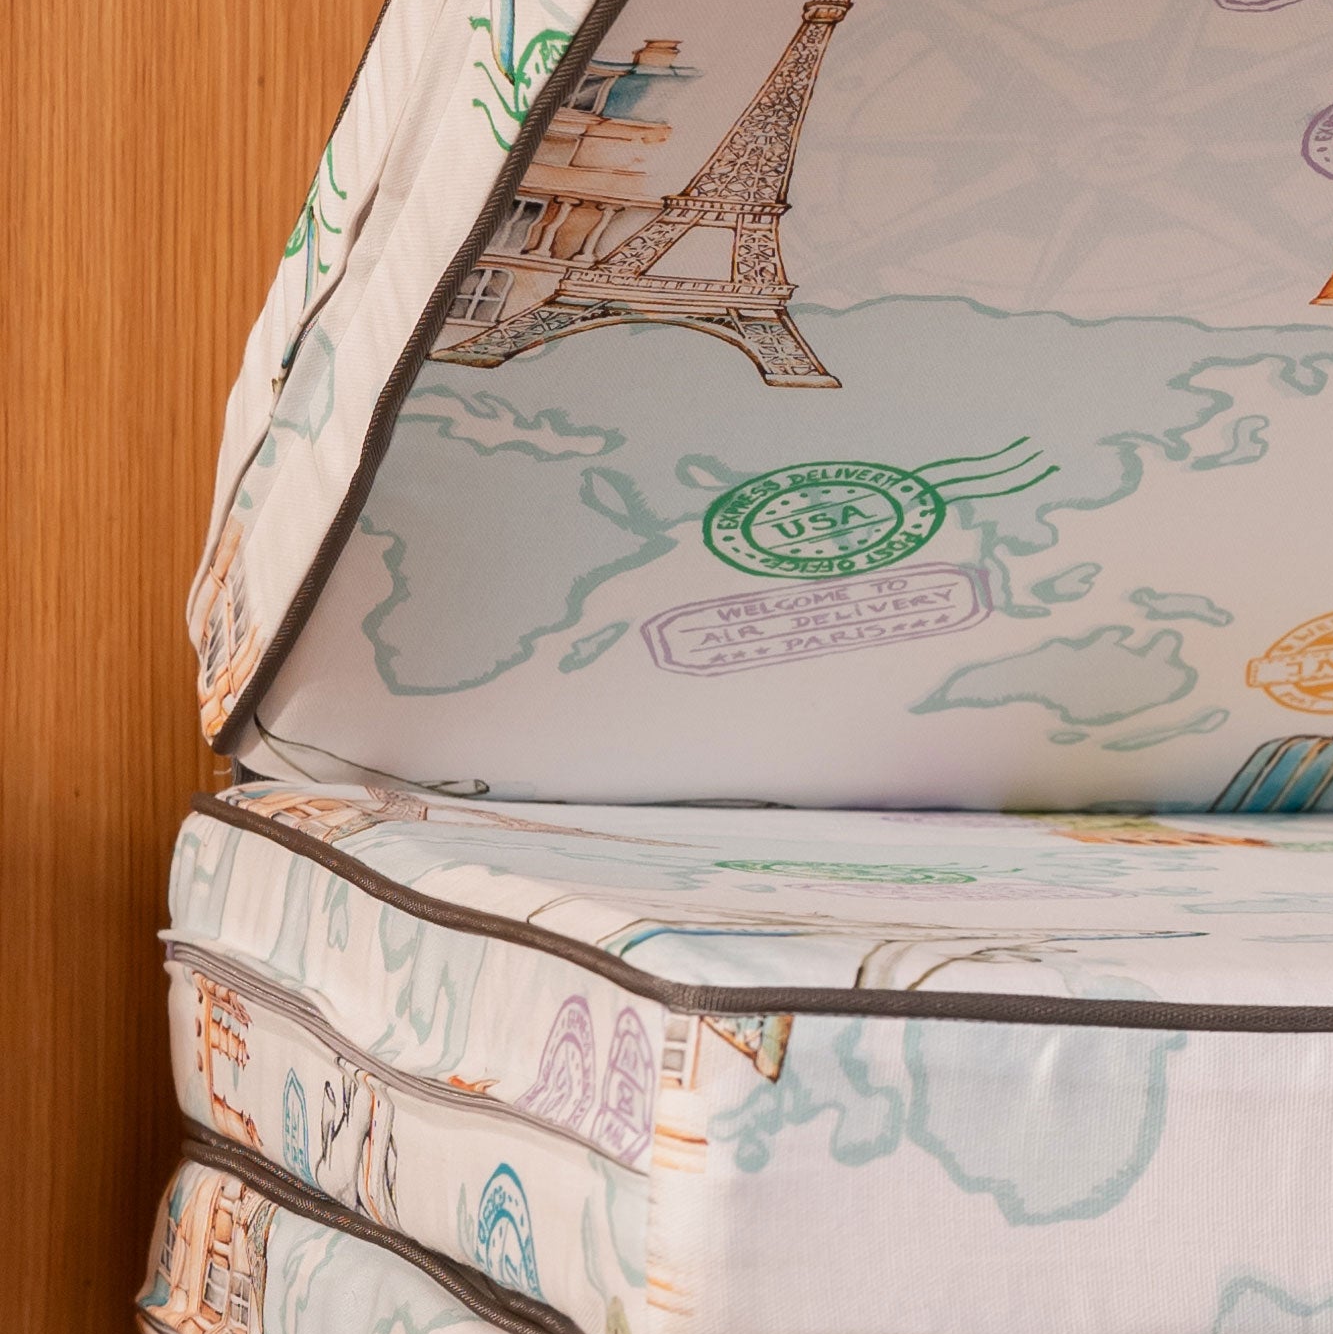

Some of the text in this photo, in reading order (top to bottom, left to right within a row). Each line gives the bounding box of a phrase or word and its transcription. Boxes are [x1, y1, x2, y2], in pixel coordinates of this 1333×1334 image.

[786, 467, 901, 489] DELIVERY
[771, 505, 878, 540] USA
[865, 530, 924, 565] POST
[715, 577, 909, 622] WELCOME TO
[699, 588, 953, 647] AIR DELIVERY
[784, 623, 888, 652] PARIS
